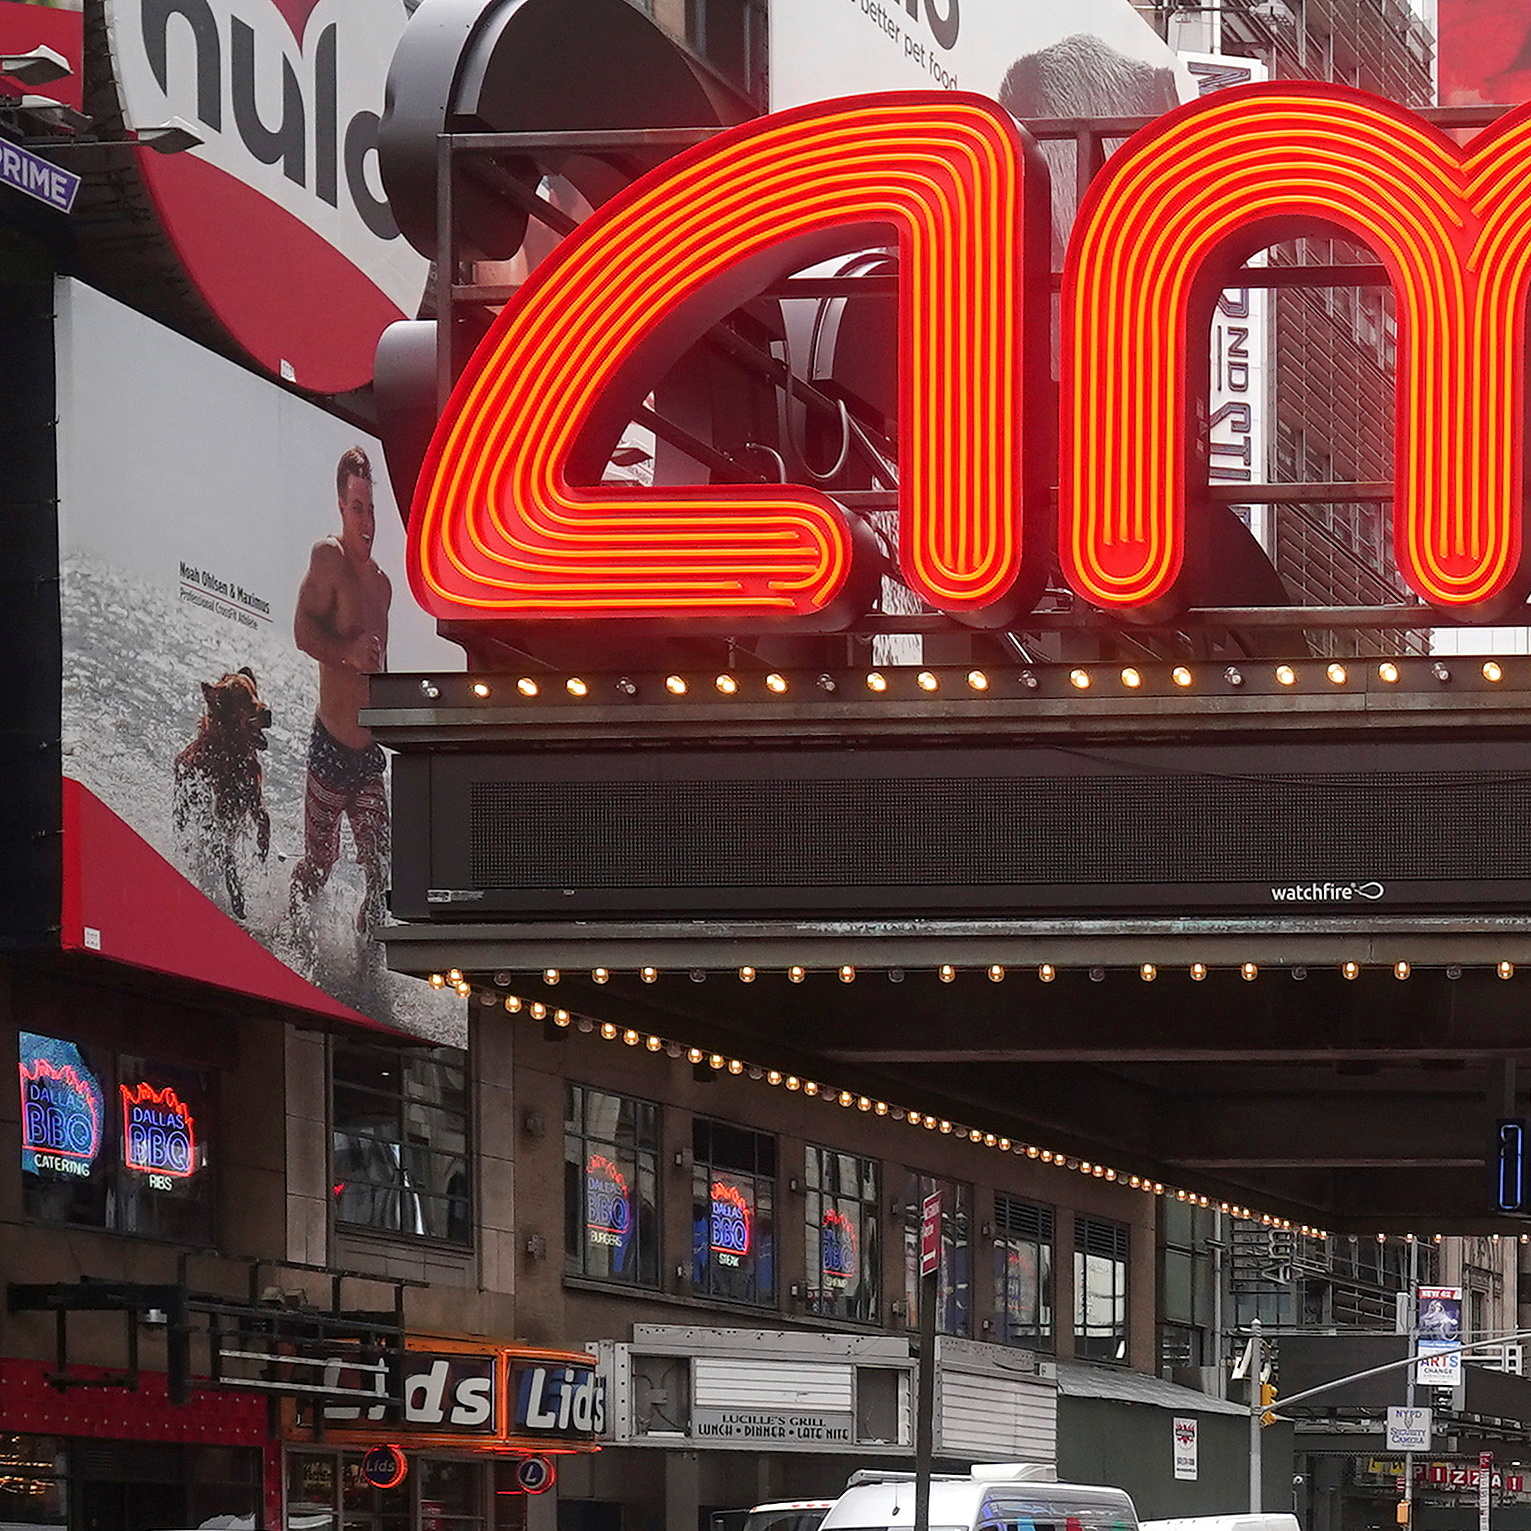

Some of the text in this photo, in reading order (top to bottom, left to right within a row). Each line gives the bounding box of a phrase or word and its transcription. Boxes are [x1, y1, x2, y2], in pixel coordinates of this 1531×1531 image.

[180, 561, 199, 582] Noah
[30, 1084, 86, 1109] DALLAS
[133, 1106, 185, 1129] DALLAS
[26, 1102, 93, 1154] BBQ
[129, 1122, 191, 1171] BBQ
[34, 1153, 90, 1177] CATERING
[149, 1174, 172, 1191] RIBS
[587, 1177, 621, 1195] DALLAS
[587, 1191, 626, 1231] BBQ
[712, 1202, 744, 1219] DALLAS
[711, 1214, 747, 1252] BBQ
[1420, 1355, 1459, 1368] ARTS
[526, 1367, 605, 1432] Lids
[722, 1414, 827, 1427] LUCILLE'S GRILL
[1395, 1410, 1423, 1419] NYPD
[698, 1424, 849, 1440] LUNCH DINNER LATE NITE
[366, 1459, 395, 1474] Lids
[525, 1464, 537, 1482] L
